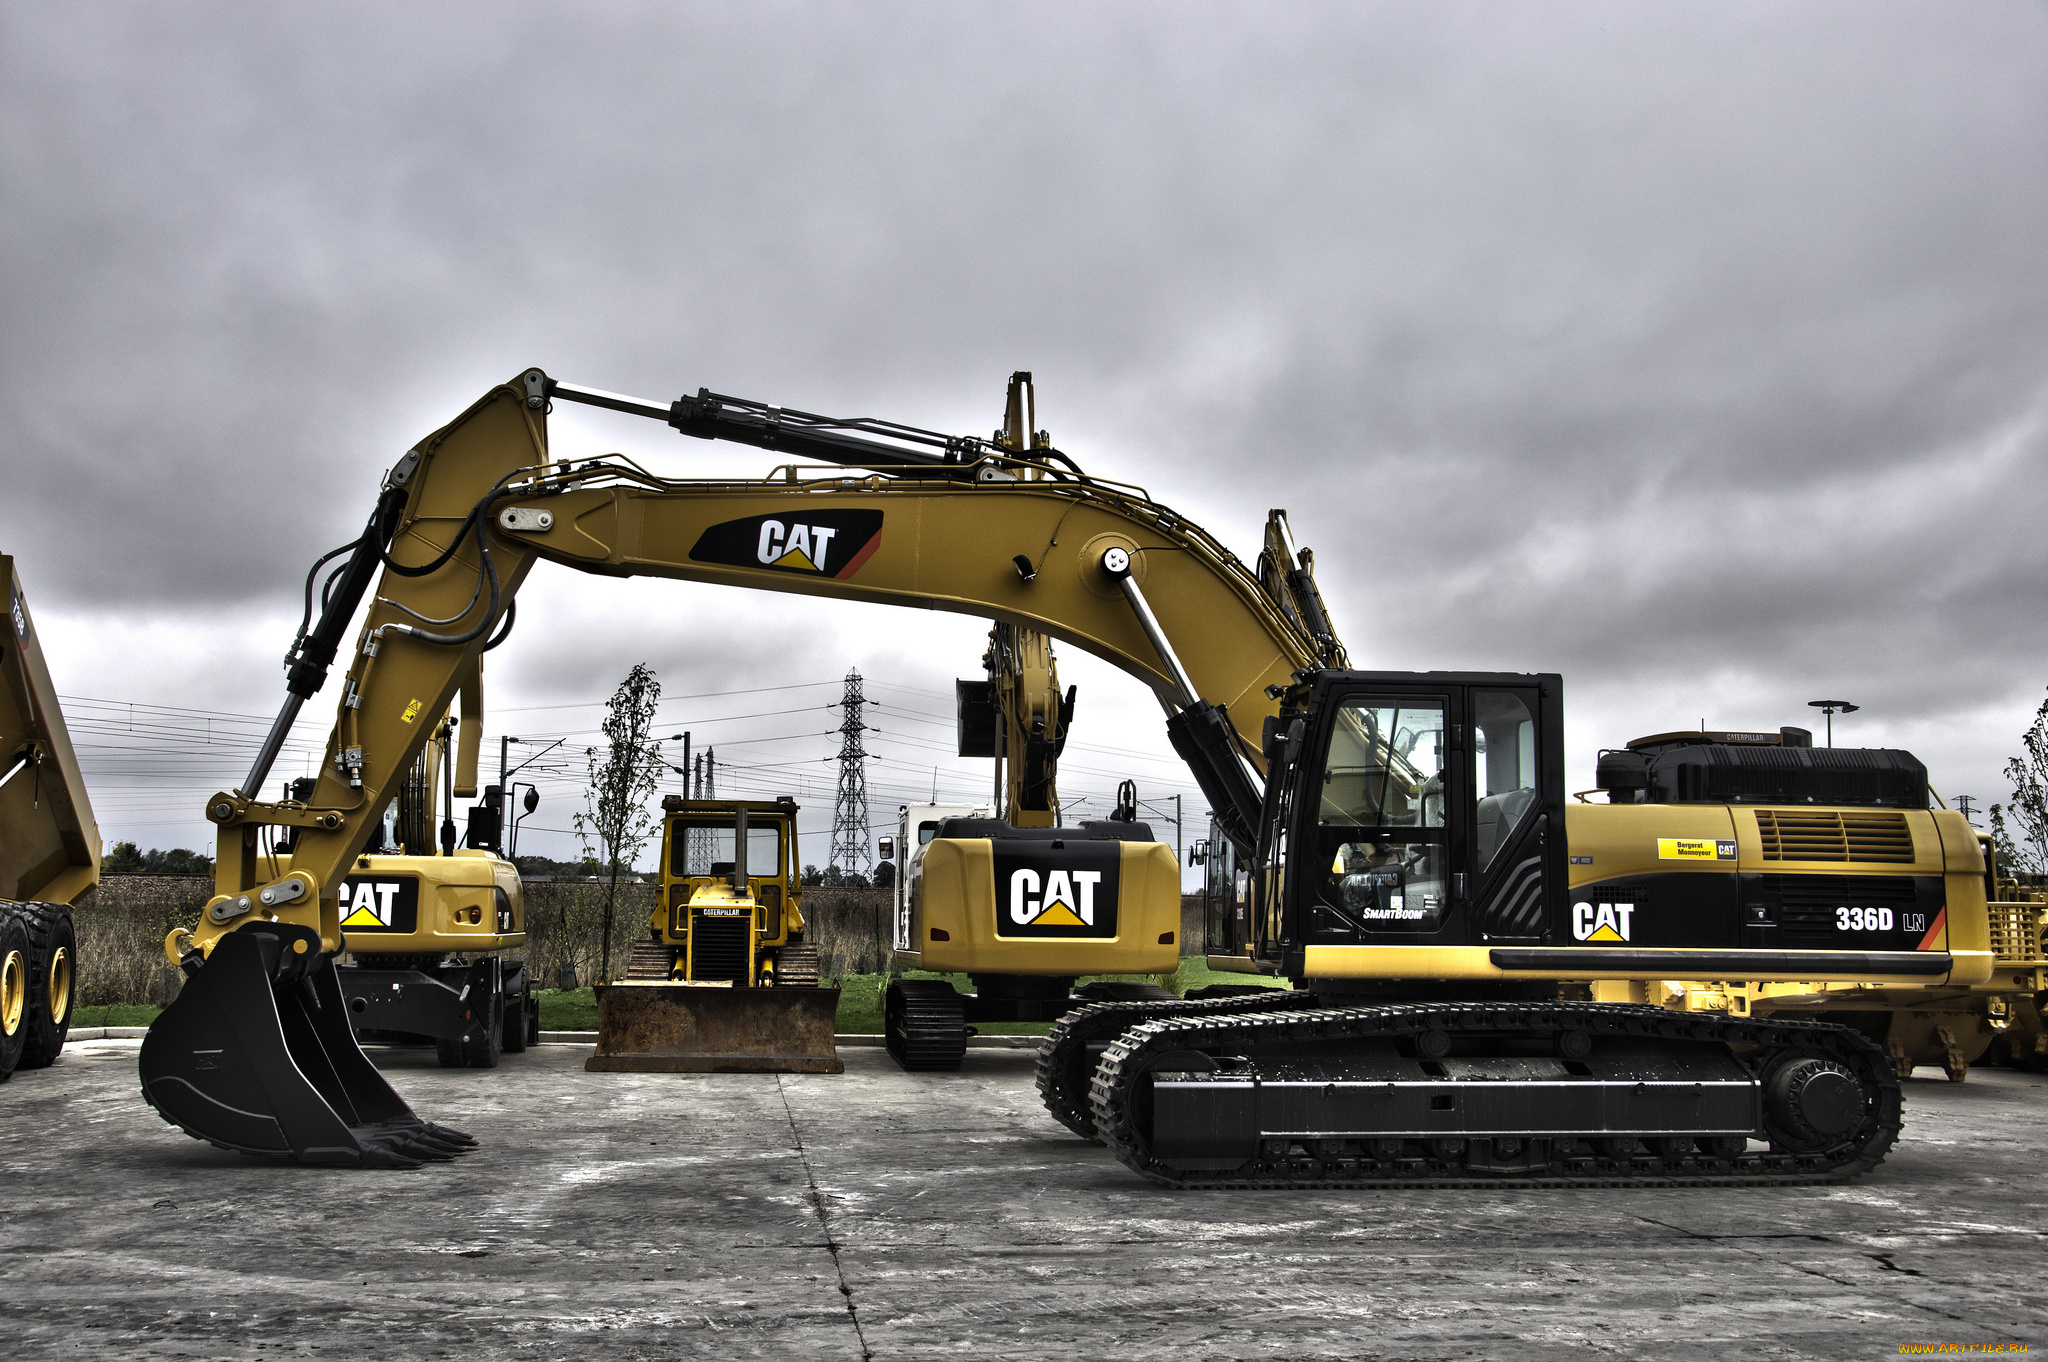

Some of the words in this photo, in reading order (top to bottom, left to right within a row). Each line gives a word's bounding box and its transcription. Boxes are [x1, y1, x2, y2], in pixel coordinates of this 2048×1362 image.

[757, 519, 836, 572] CAT
[1726, 733, 1765, 742] CATERPILLAR
[1677, 841, 1704, 850] Bergerat
[1717, 844, 1735, 856] CAT
[1677, 848, 1712, 857] Monnoyeur
[1010, 868, 1102, 926] CAT
[703, 908, 741, 916] CATERPILLAR
[1572, 901, 1635, 942] CAT
[1835, 906, 1894, 931] 336D
[1902, 913, 1925, 932] LN
